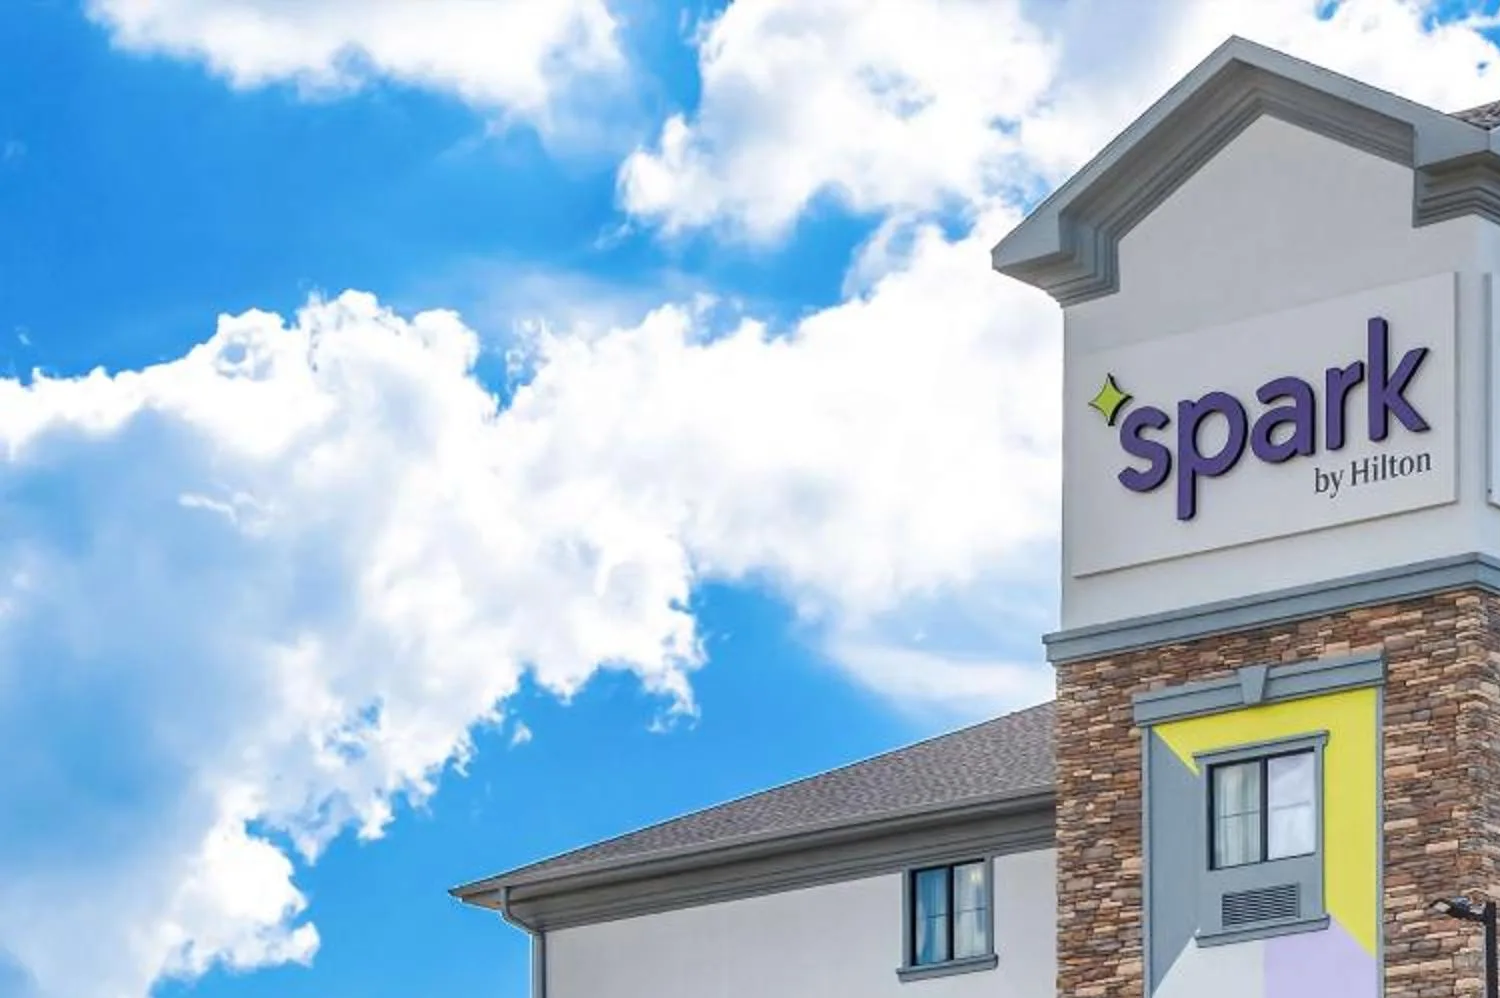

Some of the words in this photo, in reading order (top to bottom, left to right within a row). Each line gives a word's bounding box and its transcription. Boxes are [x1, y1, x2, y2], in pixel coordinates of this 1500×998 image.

[1117, 316, 1431, 521] spark
[1313, 466, 1344, 498] by
[1350, 448, 1433, 488] Hilton
